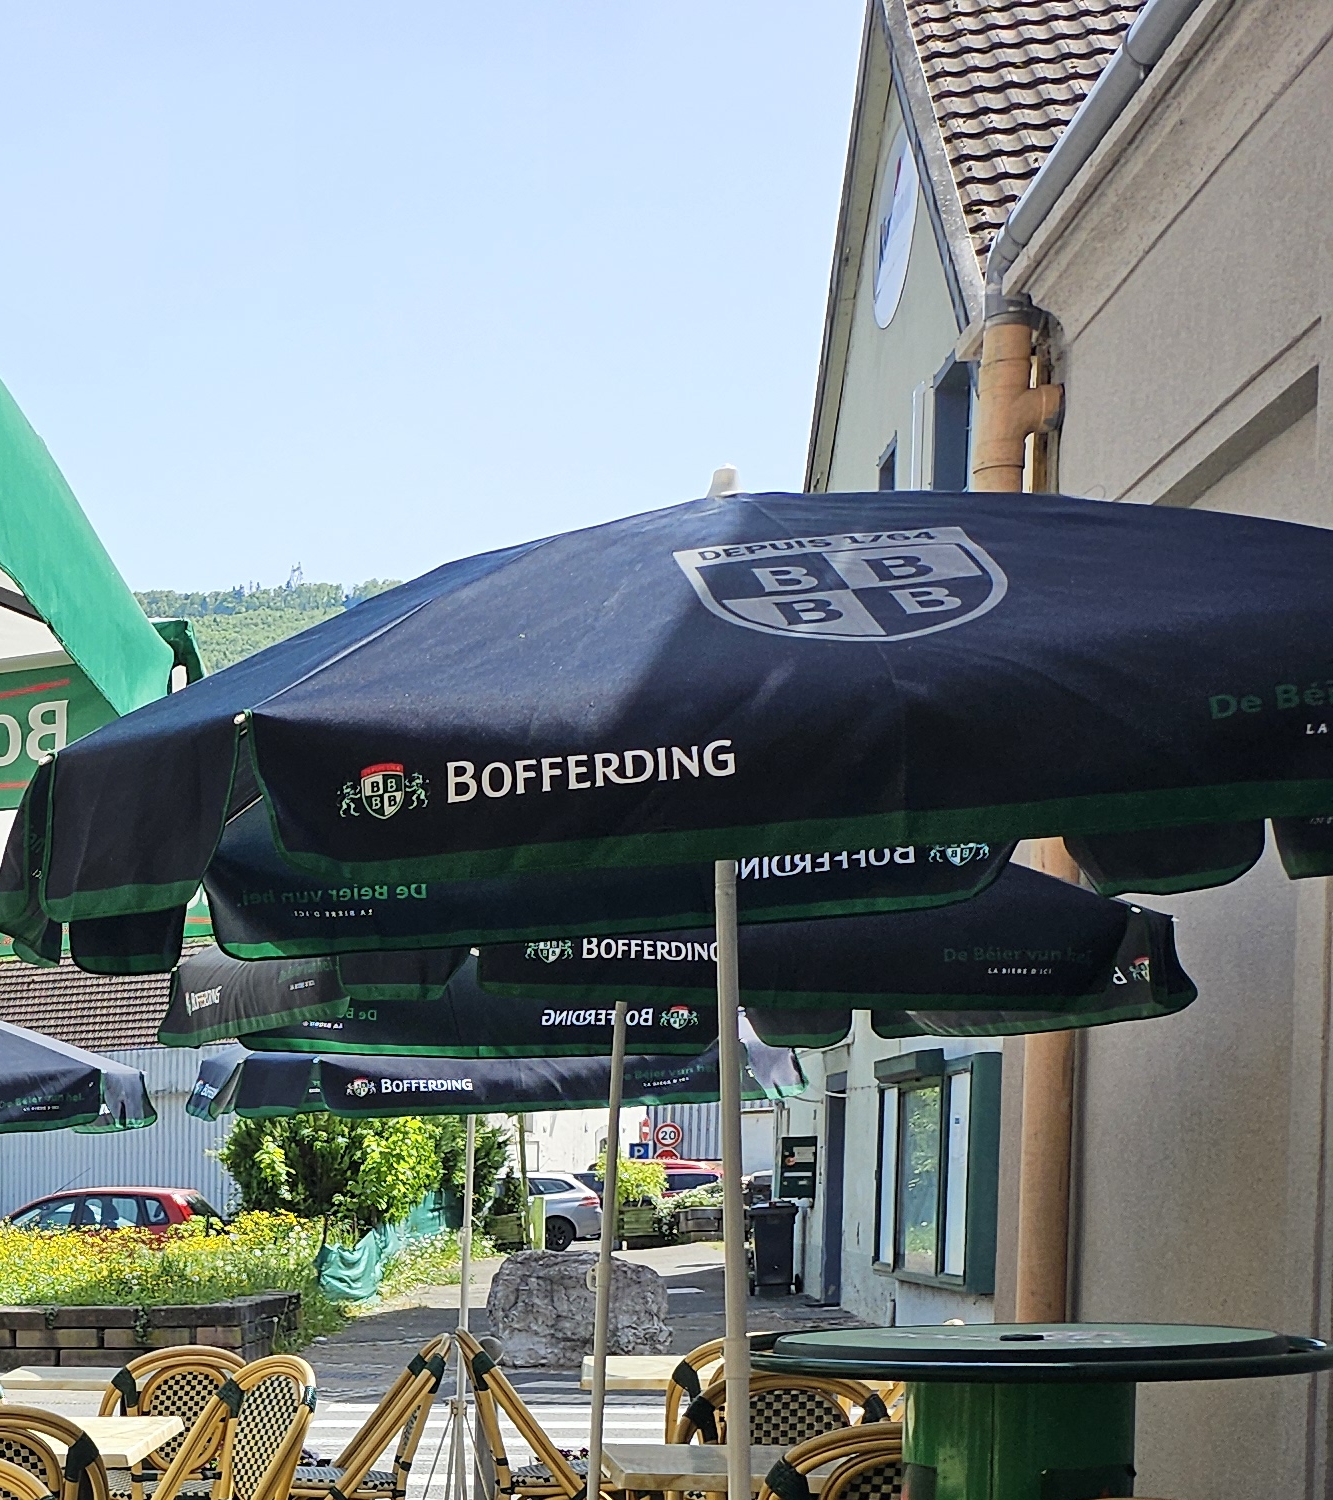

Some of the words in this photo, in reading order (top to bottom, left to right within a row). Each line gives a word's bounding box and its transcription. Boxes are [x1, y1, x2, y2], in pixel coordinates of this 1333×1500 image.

[698, 537, 833, 562] DEPUIS
[842, 530, 938, 546] 1764
[750, 566, 819, 593] B
[862, 555, 933, 582] B
[772, 598, 844, 627] B
[889, 587, 962, 615] B
[1209, 694, 1263, 719] De
[1306, 724, 1328, 734] LA
[446, 739, 736, 803] BOFFERDING
[381, 1078, 473, 1093] BOFFERDING
[660, 1130, 676, 1141] 20
[636, 1149, 643, 1159] P
